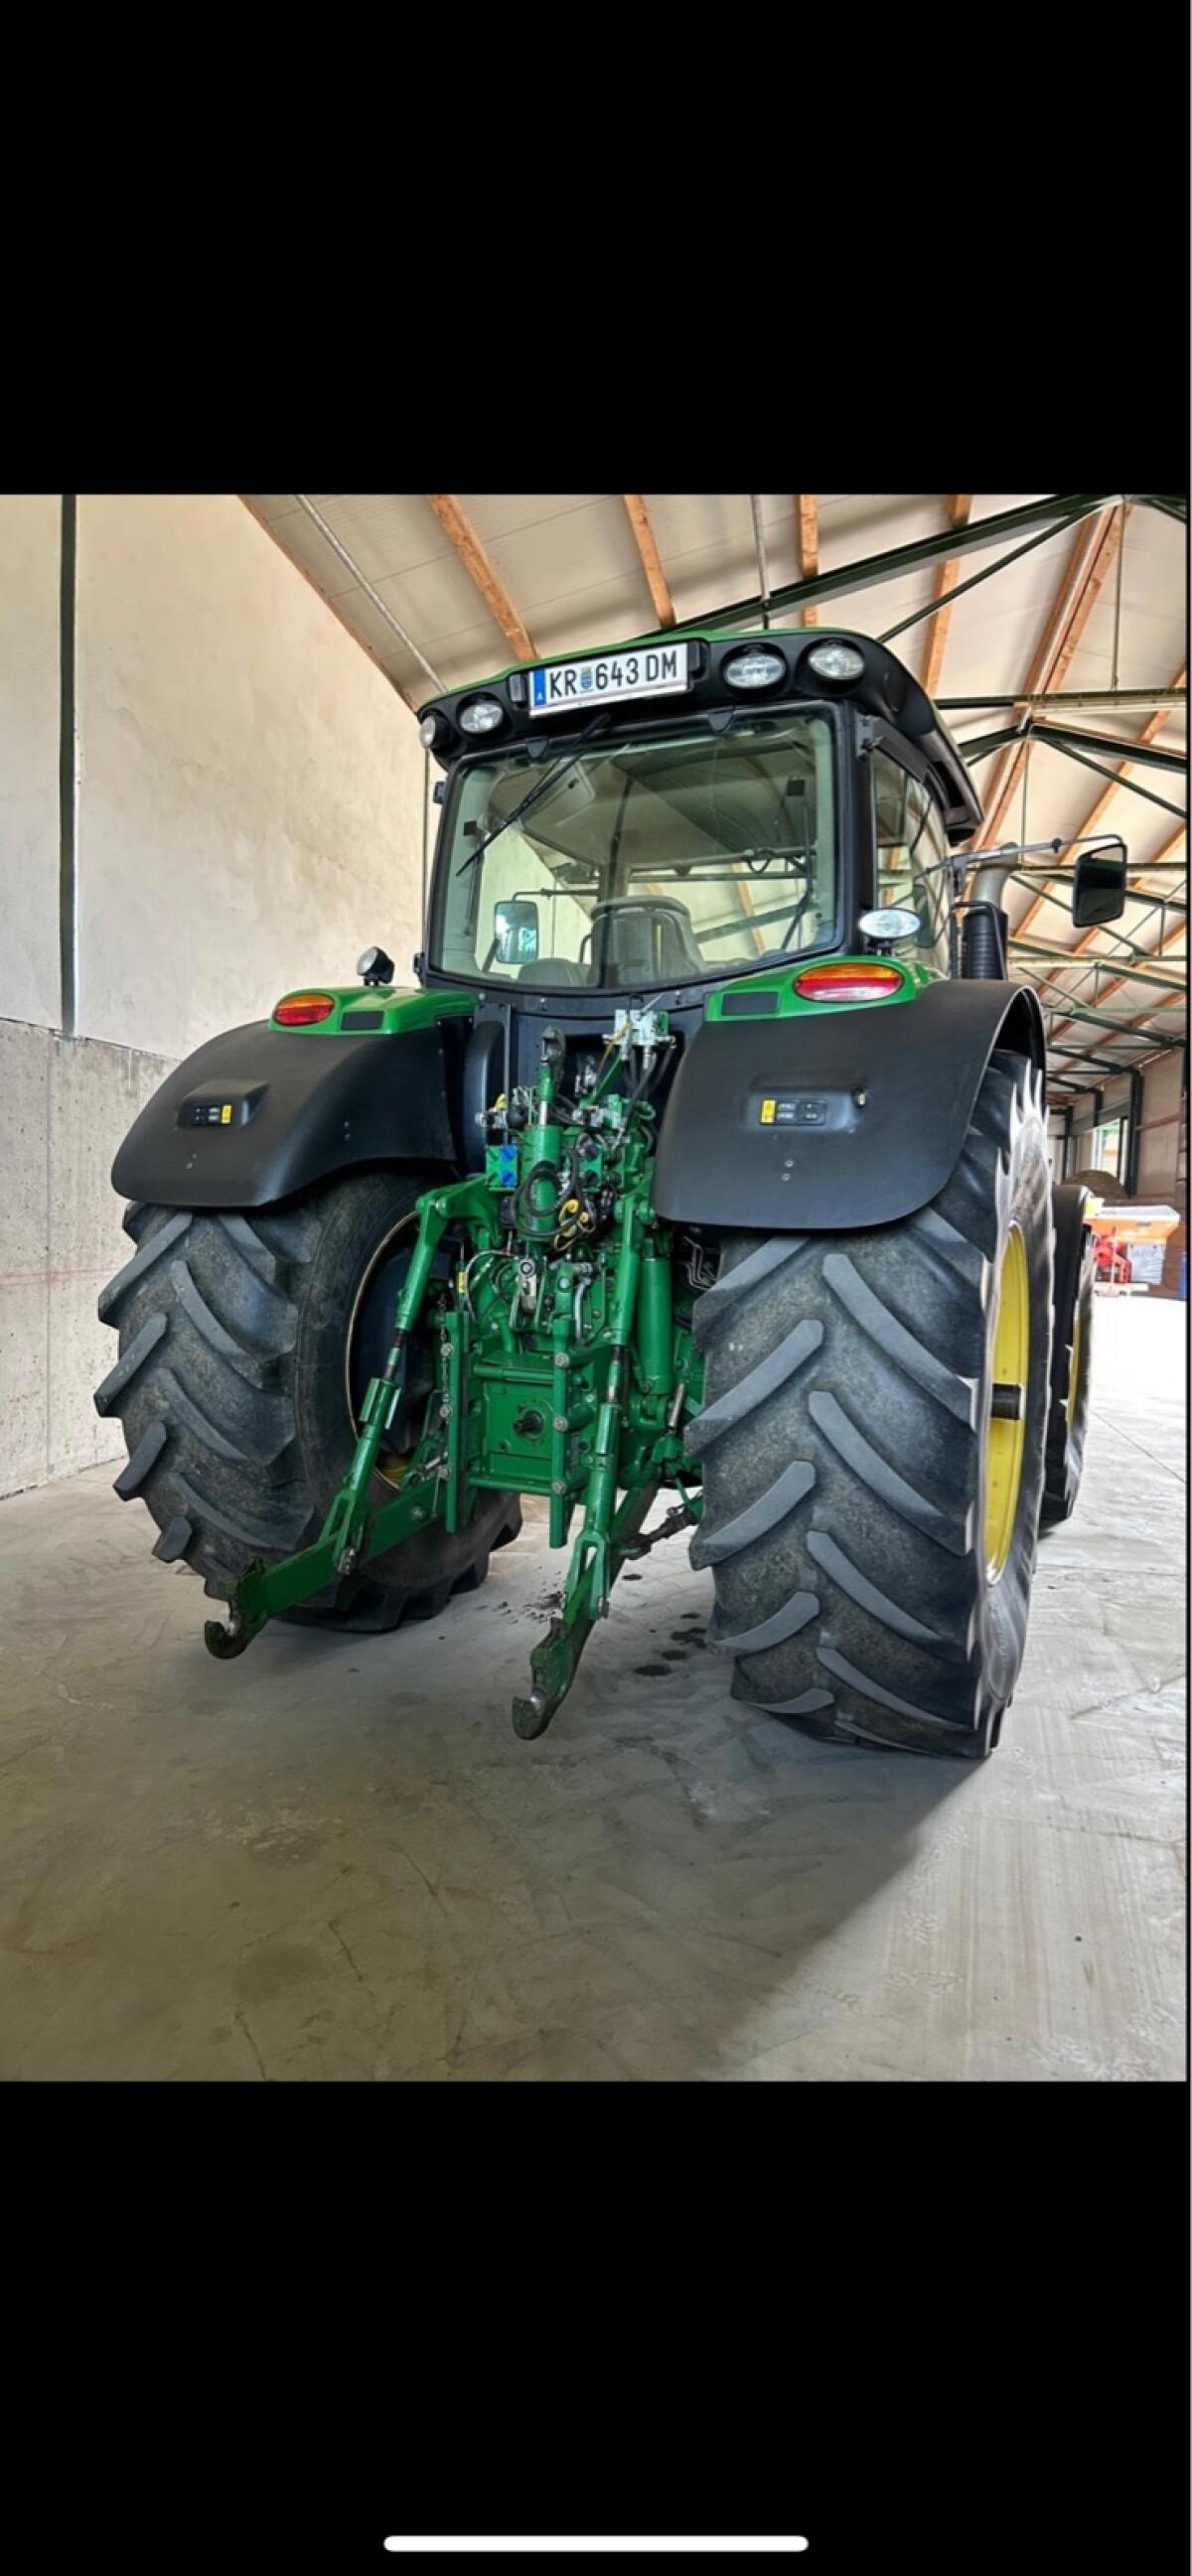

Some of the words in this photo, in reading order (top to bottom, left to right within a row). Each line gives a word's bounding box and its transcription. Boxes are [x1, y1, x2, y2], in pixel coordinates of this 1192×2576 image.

[549, 669, 577, 699] KR
[595, 657, 639, 690] 643
[647, 649, 676, 681] DM
